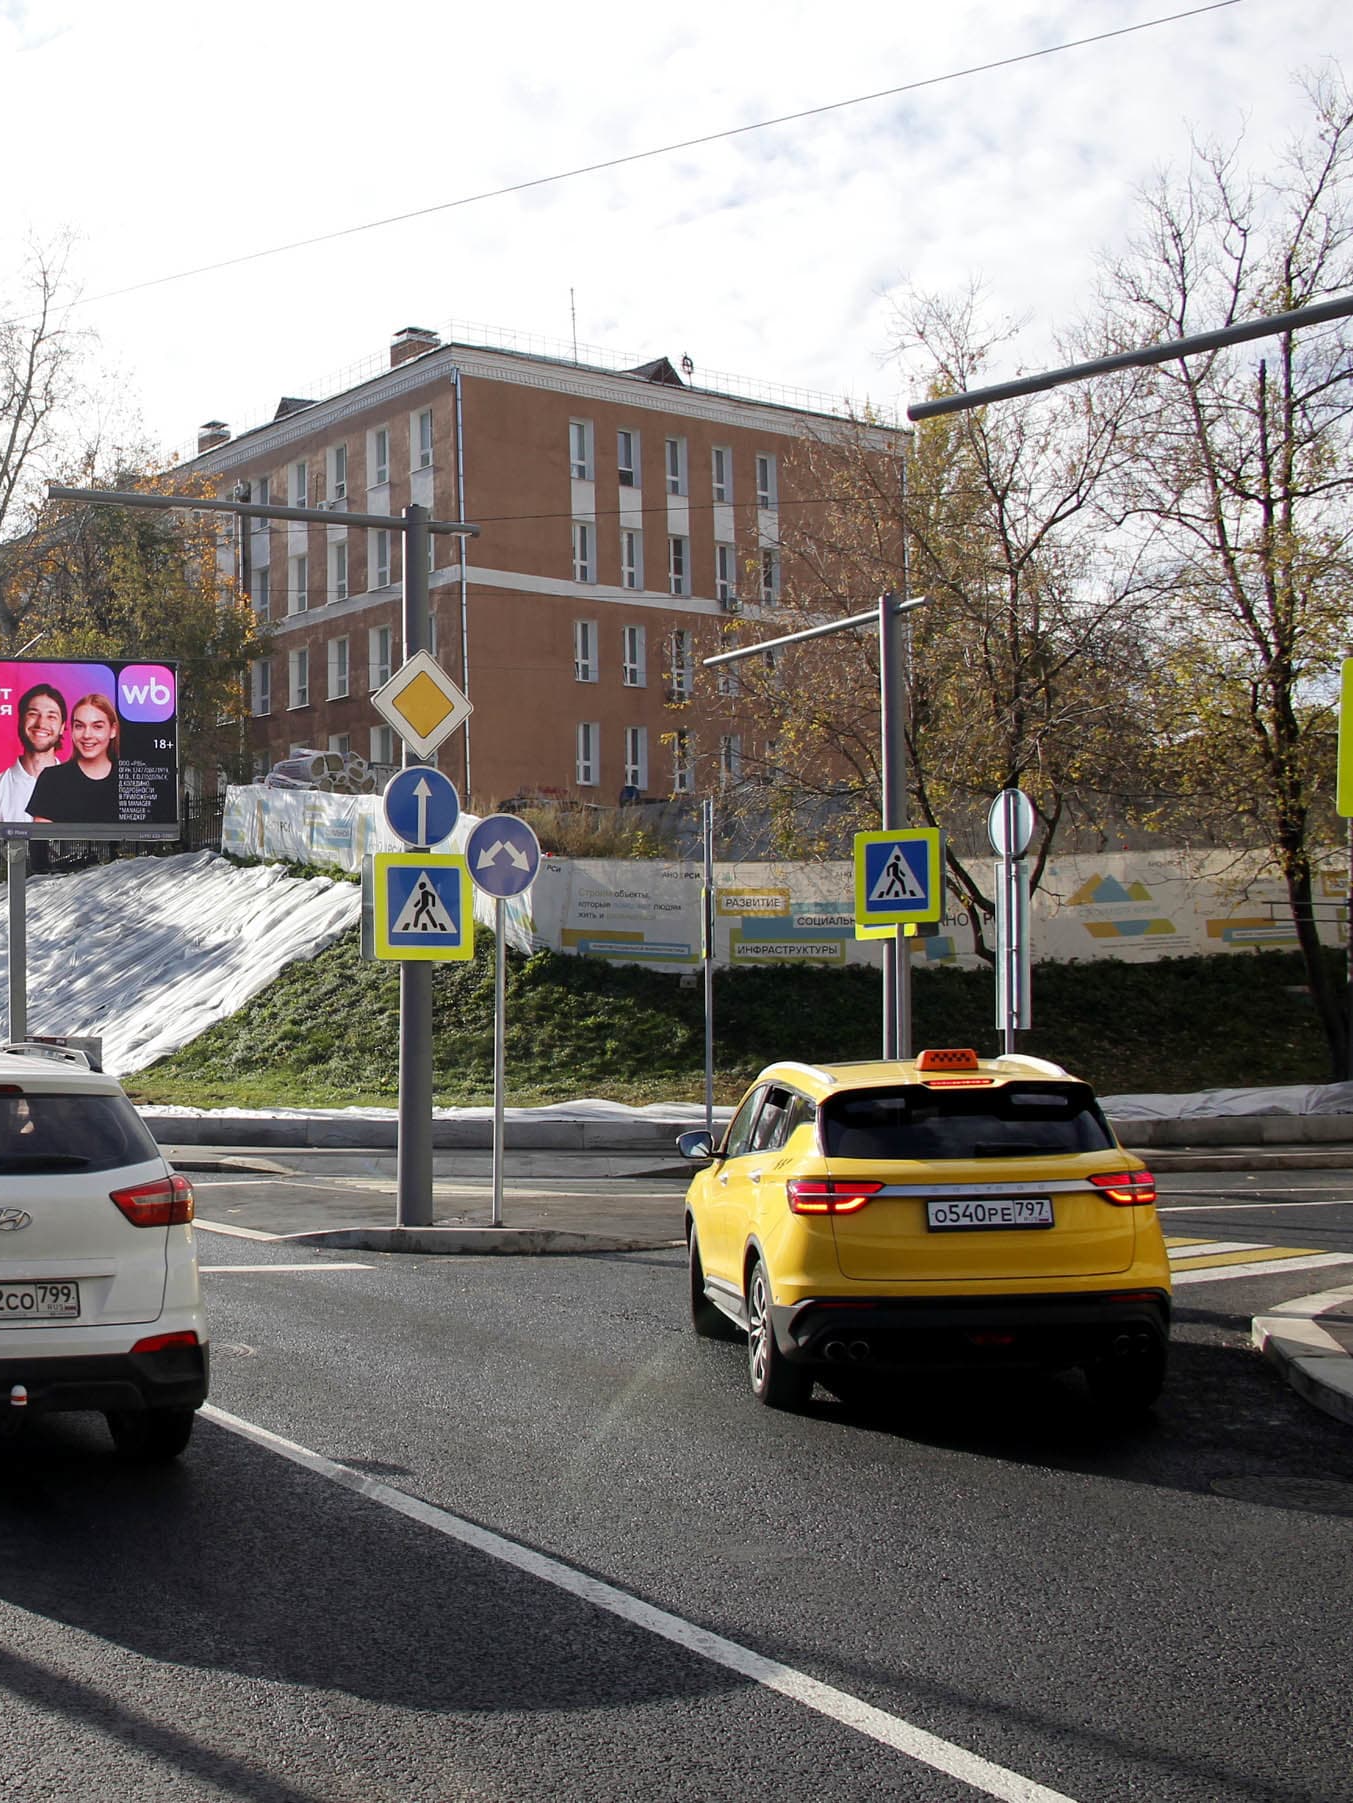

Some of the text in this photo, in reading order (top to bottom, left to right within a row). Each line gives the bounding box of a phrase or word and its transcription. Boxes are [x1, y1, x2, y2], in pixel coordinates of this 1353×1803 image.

[121, 677, 171, 705] wb
[153, 739, 175, 750] 18+
[725, 898, 781, 908] РАЗВИТИЕ
[737, 945, 838, 955] ИНФРАСТРУКТУРЫ
[934, 1202, 1045, 1223] О540РЕ 797
[38, 1285, 71, 1303] 799
